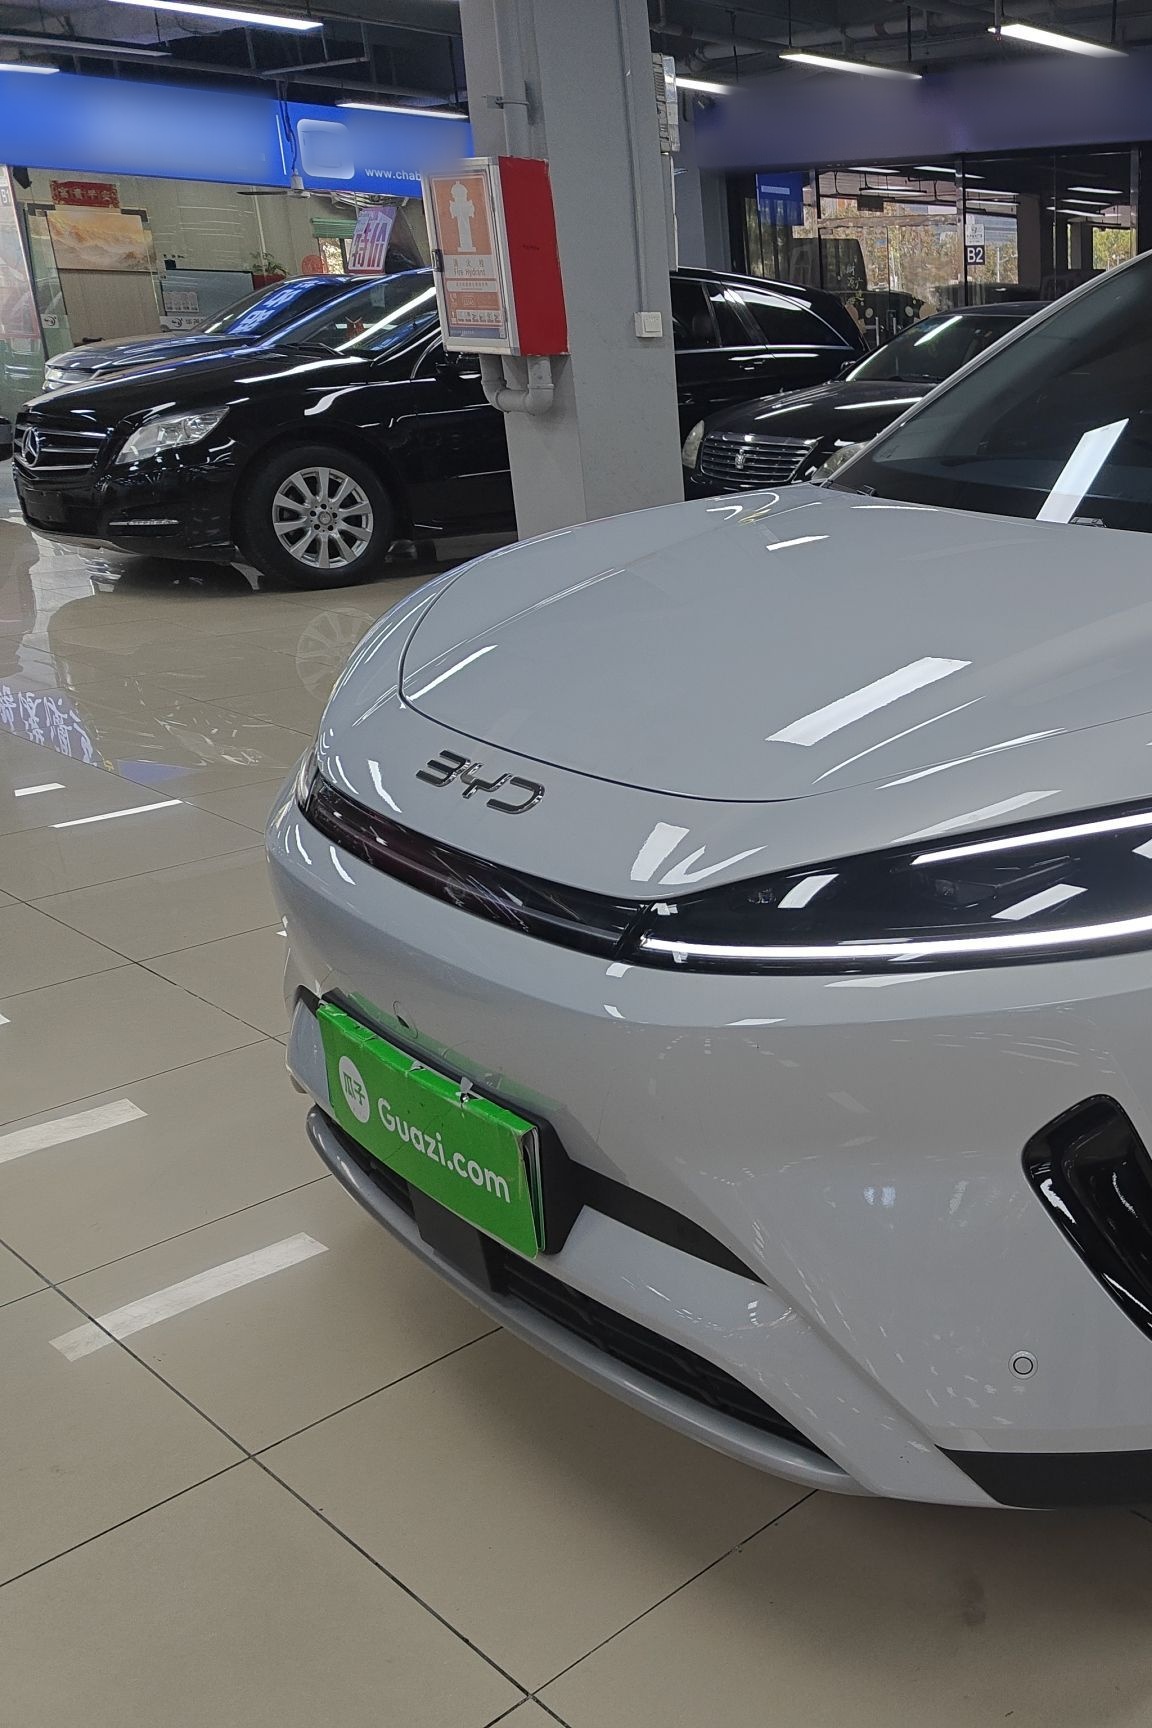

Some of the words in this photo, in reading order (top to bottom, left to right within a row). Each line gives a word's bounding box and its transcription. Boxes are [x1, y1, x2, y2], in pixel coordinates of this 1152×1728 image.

[967, 247, 984, 263] B2
[415, 749, 545, 815] BYD
[343, 1072, 366, 1107] 瓜子
[377, 1097, 511, 1204] Guazi.com
